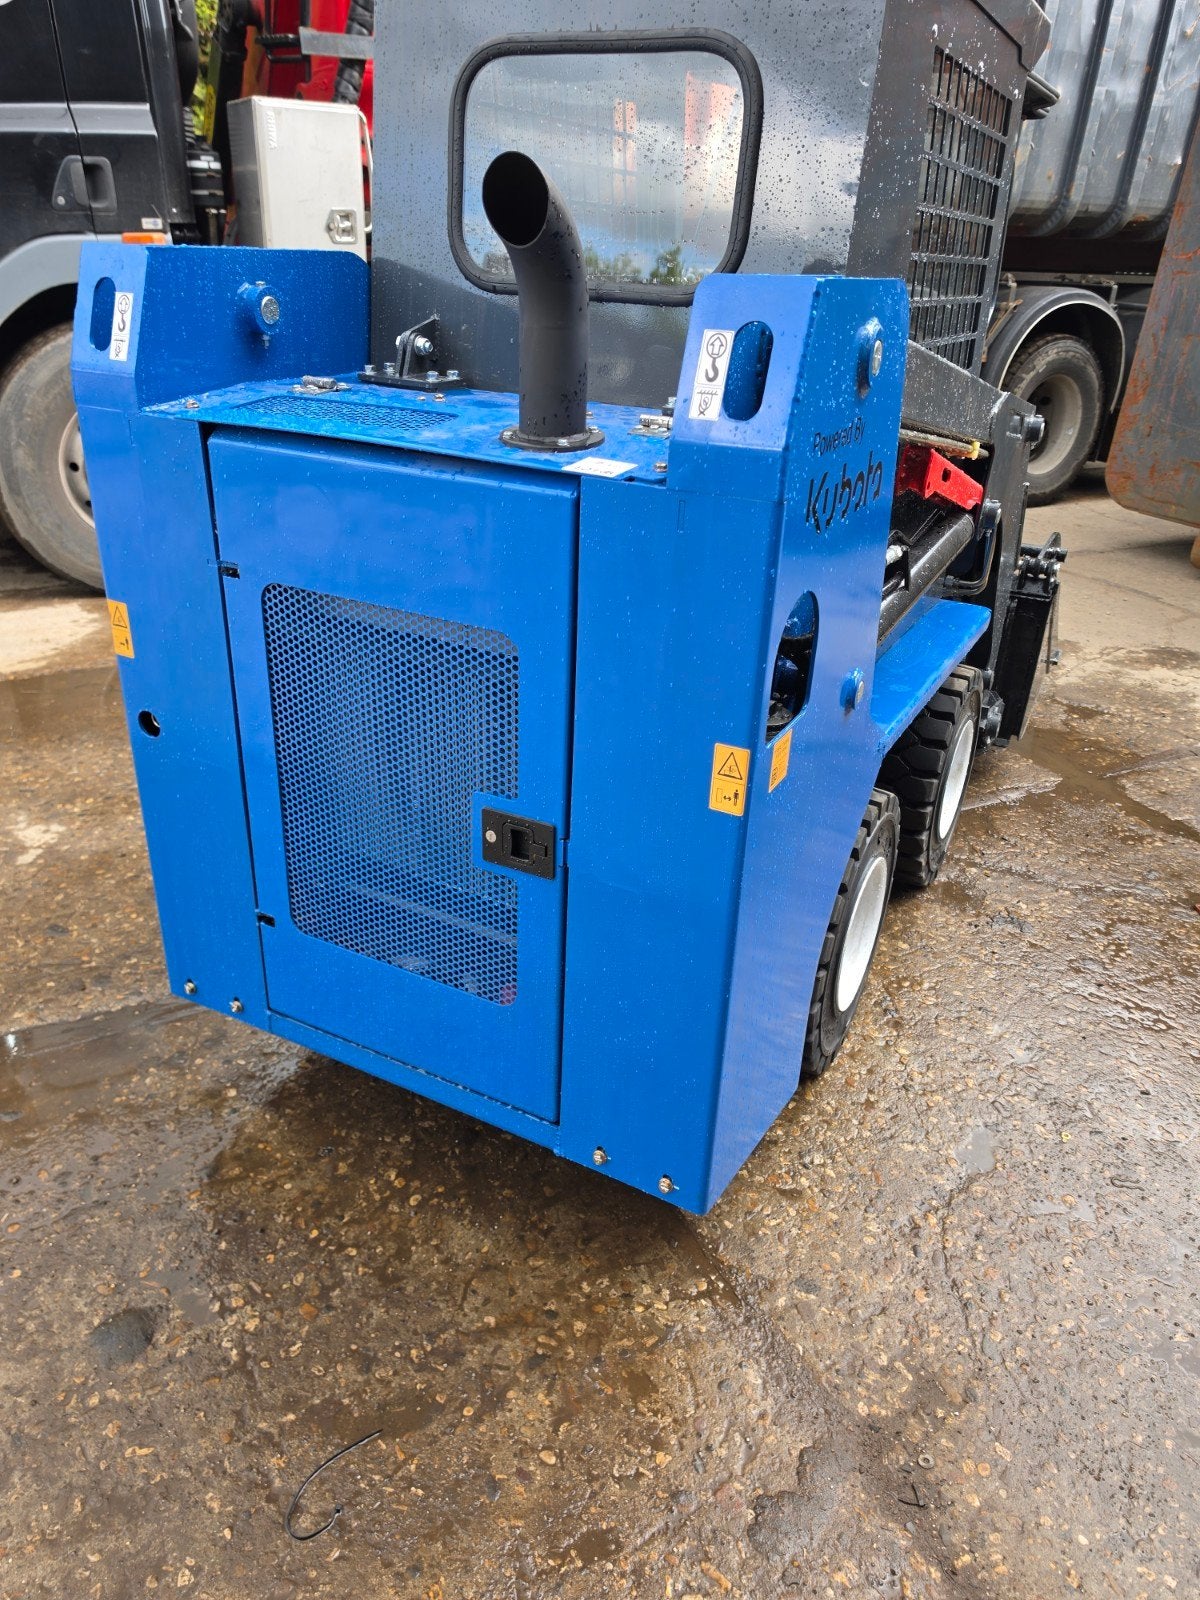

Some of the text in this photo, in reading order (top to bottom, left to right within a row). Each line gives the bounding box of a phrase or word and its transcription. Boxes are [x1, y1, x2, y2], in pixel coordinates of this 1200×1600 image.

[813, 416, 866, 456] Powered By
[805, 449, 883, 535] Kubota
